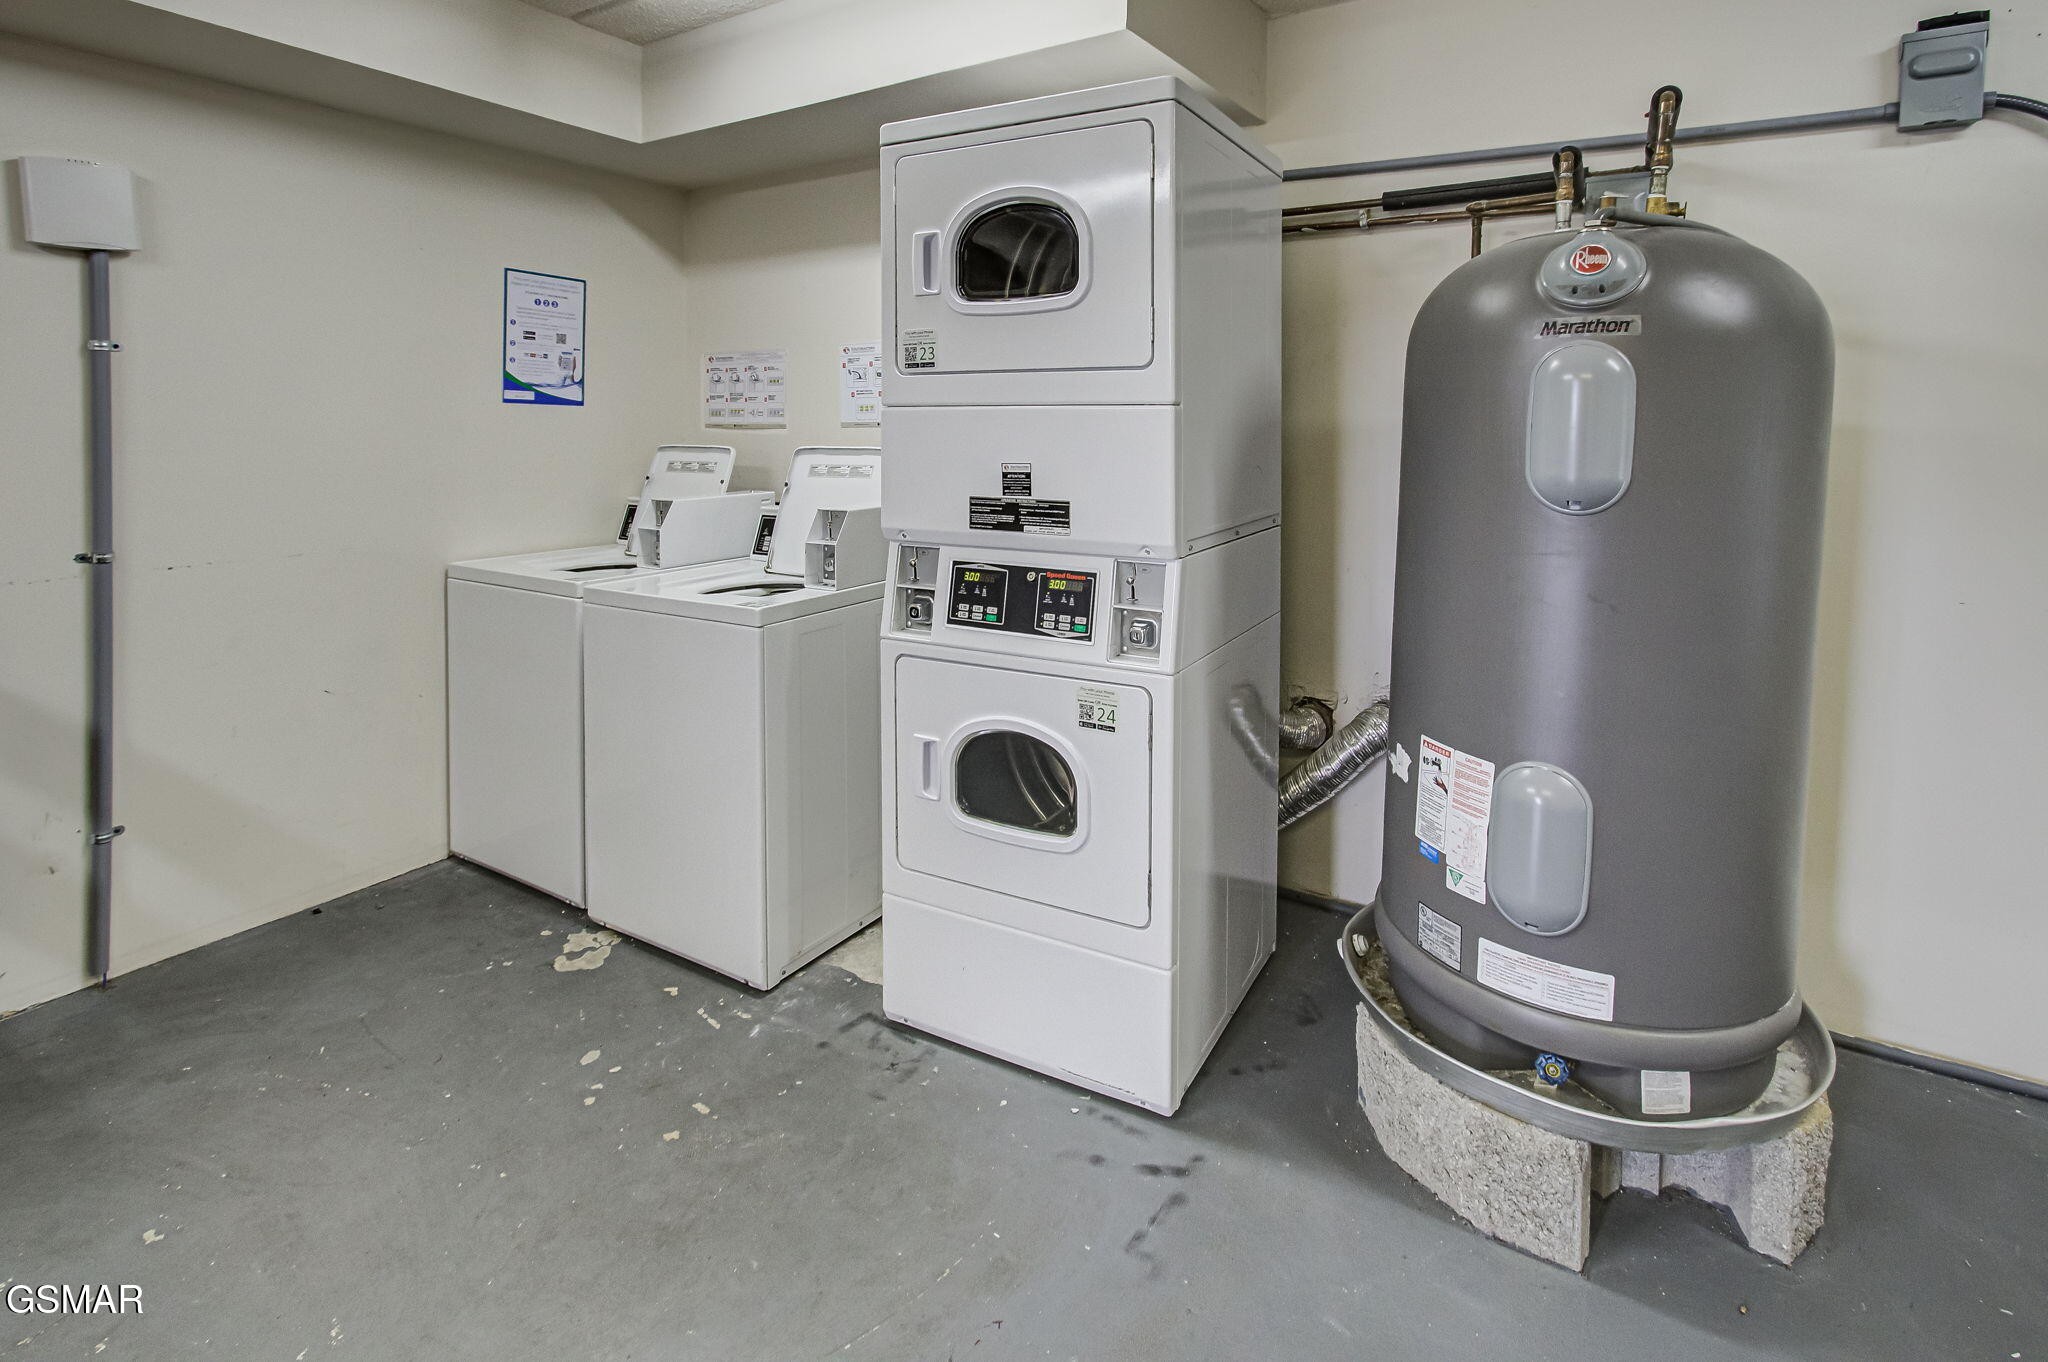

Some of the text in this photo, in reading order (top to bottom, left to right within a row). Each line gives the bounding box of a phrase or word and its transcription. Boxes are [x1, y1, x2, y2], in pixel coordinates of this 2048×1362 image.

[1574, 247, 1608, 269] Rheem
[1540, 318, 1632, 336] Marathon
[919, 346, 935, 361] 23
[1066, 573, 1087, 581] Queen
[1097, 707, 1117, 724] 24
